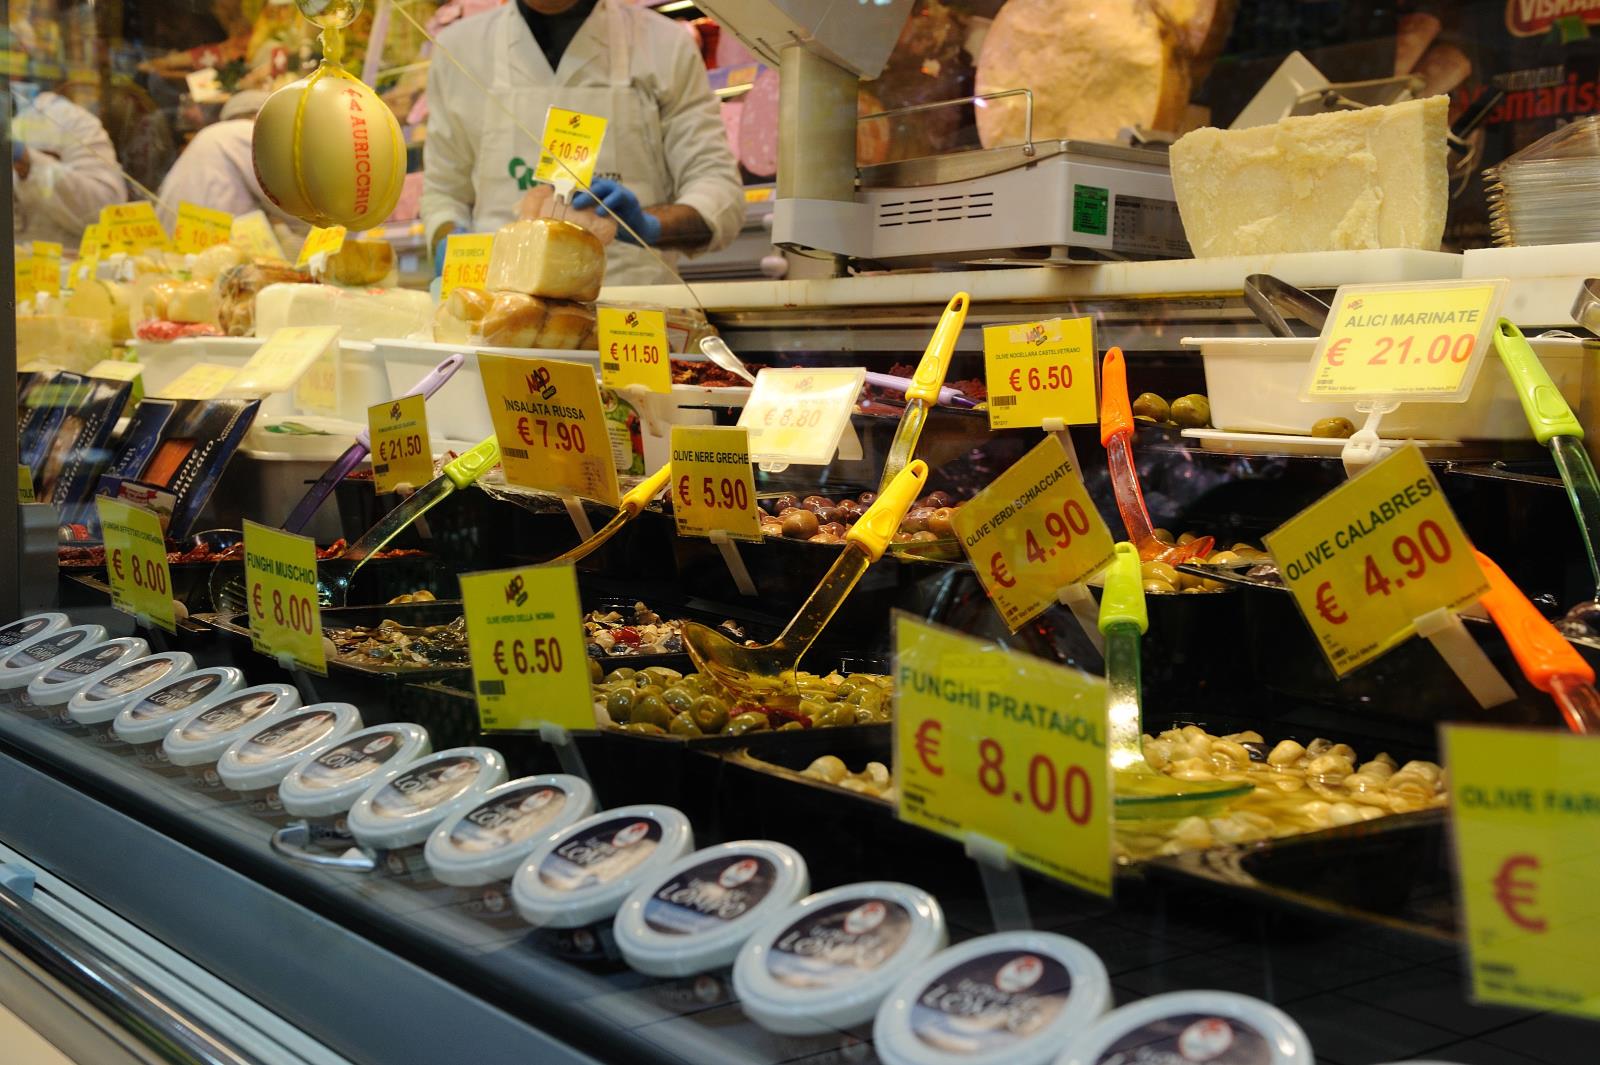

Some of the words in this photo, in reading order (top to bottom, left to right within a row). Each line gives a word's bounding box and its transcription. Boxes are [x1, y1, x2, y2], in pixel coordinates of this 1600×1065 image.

[351, 116, 371, 215] AURICCHIO
[1344, 314, 1389, 328] ALICI
[1391, 309, 1479, 327] MARINATE
[610, 343, 618, 361] €
[622, 344, 659, 364] 11.50
[1326, 338, 1352, 366] €
[1367, 334, 1476, 366] 21.00
[1009, 368, 1022, 392] €
[1028, 364, 1073, 391] 6.50
[504, 396, 551, 416] INSALATA
[552, 405, 586, 421] RUSSA
[379, 442, 387, 461] €
[389, 435, 422, 460] 21.50
[517, 417, 534, 446] €
[536, 419, 586, 453] 7.90
[673, 450, 693, 461] OLIVE
[694, 451, 715, 463] NERE
[716, 452, 749, 464] GRECHE
[679, 475, 691, 506] €
[703, 478, 748, 510] 5.90
[966, 523, 990, 548] OLIVE
[989, 505, 1016, 529] VERDI
[1015, 461, 1073, 510] SCHIACCIATE
[990, 551, 1017, 588] €
[1026, 499, 1090, 564] 4.90
[1286, 540, 1335, 582] OLIVE
[112, 549, 124, 580] €
[131, 554, 167, 595] 8.00
[247, 552, 274, 574] FUNGHI
[275, 561, 315, 585] MUSCHIO
[1315, 581, 1348, 625] €
[1364, 519, 1453, 597] 4.90
[253, 583, 264, 619] €
[272, 589, 313, 636] 8.00
[493, 640, 509, 675] €
[512, 637, 563, 674] 6.50
[900, 665, 981, 709] FUNGHI
[914, 718, 945, 777] €
[978, 738, 1093, 827] 8.00
[1492, 854, 1548, 933] €
